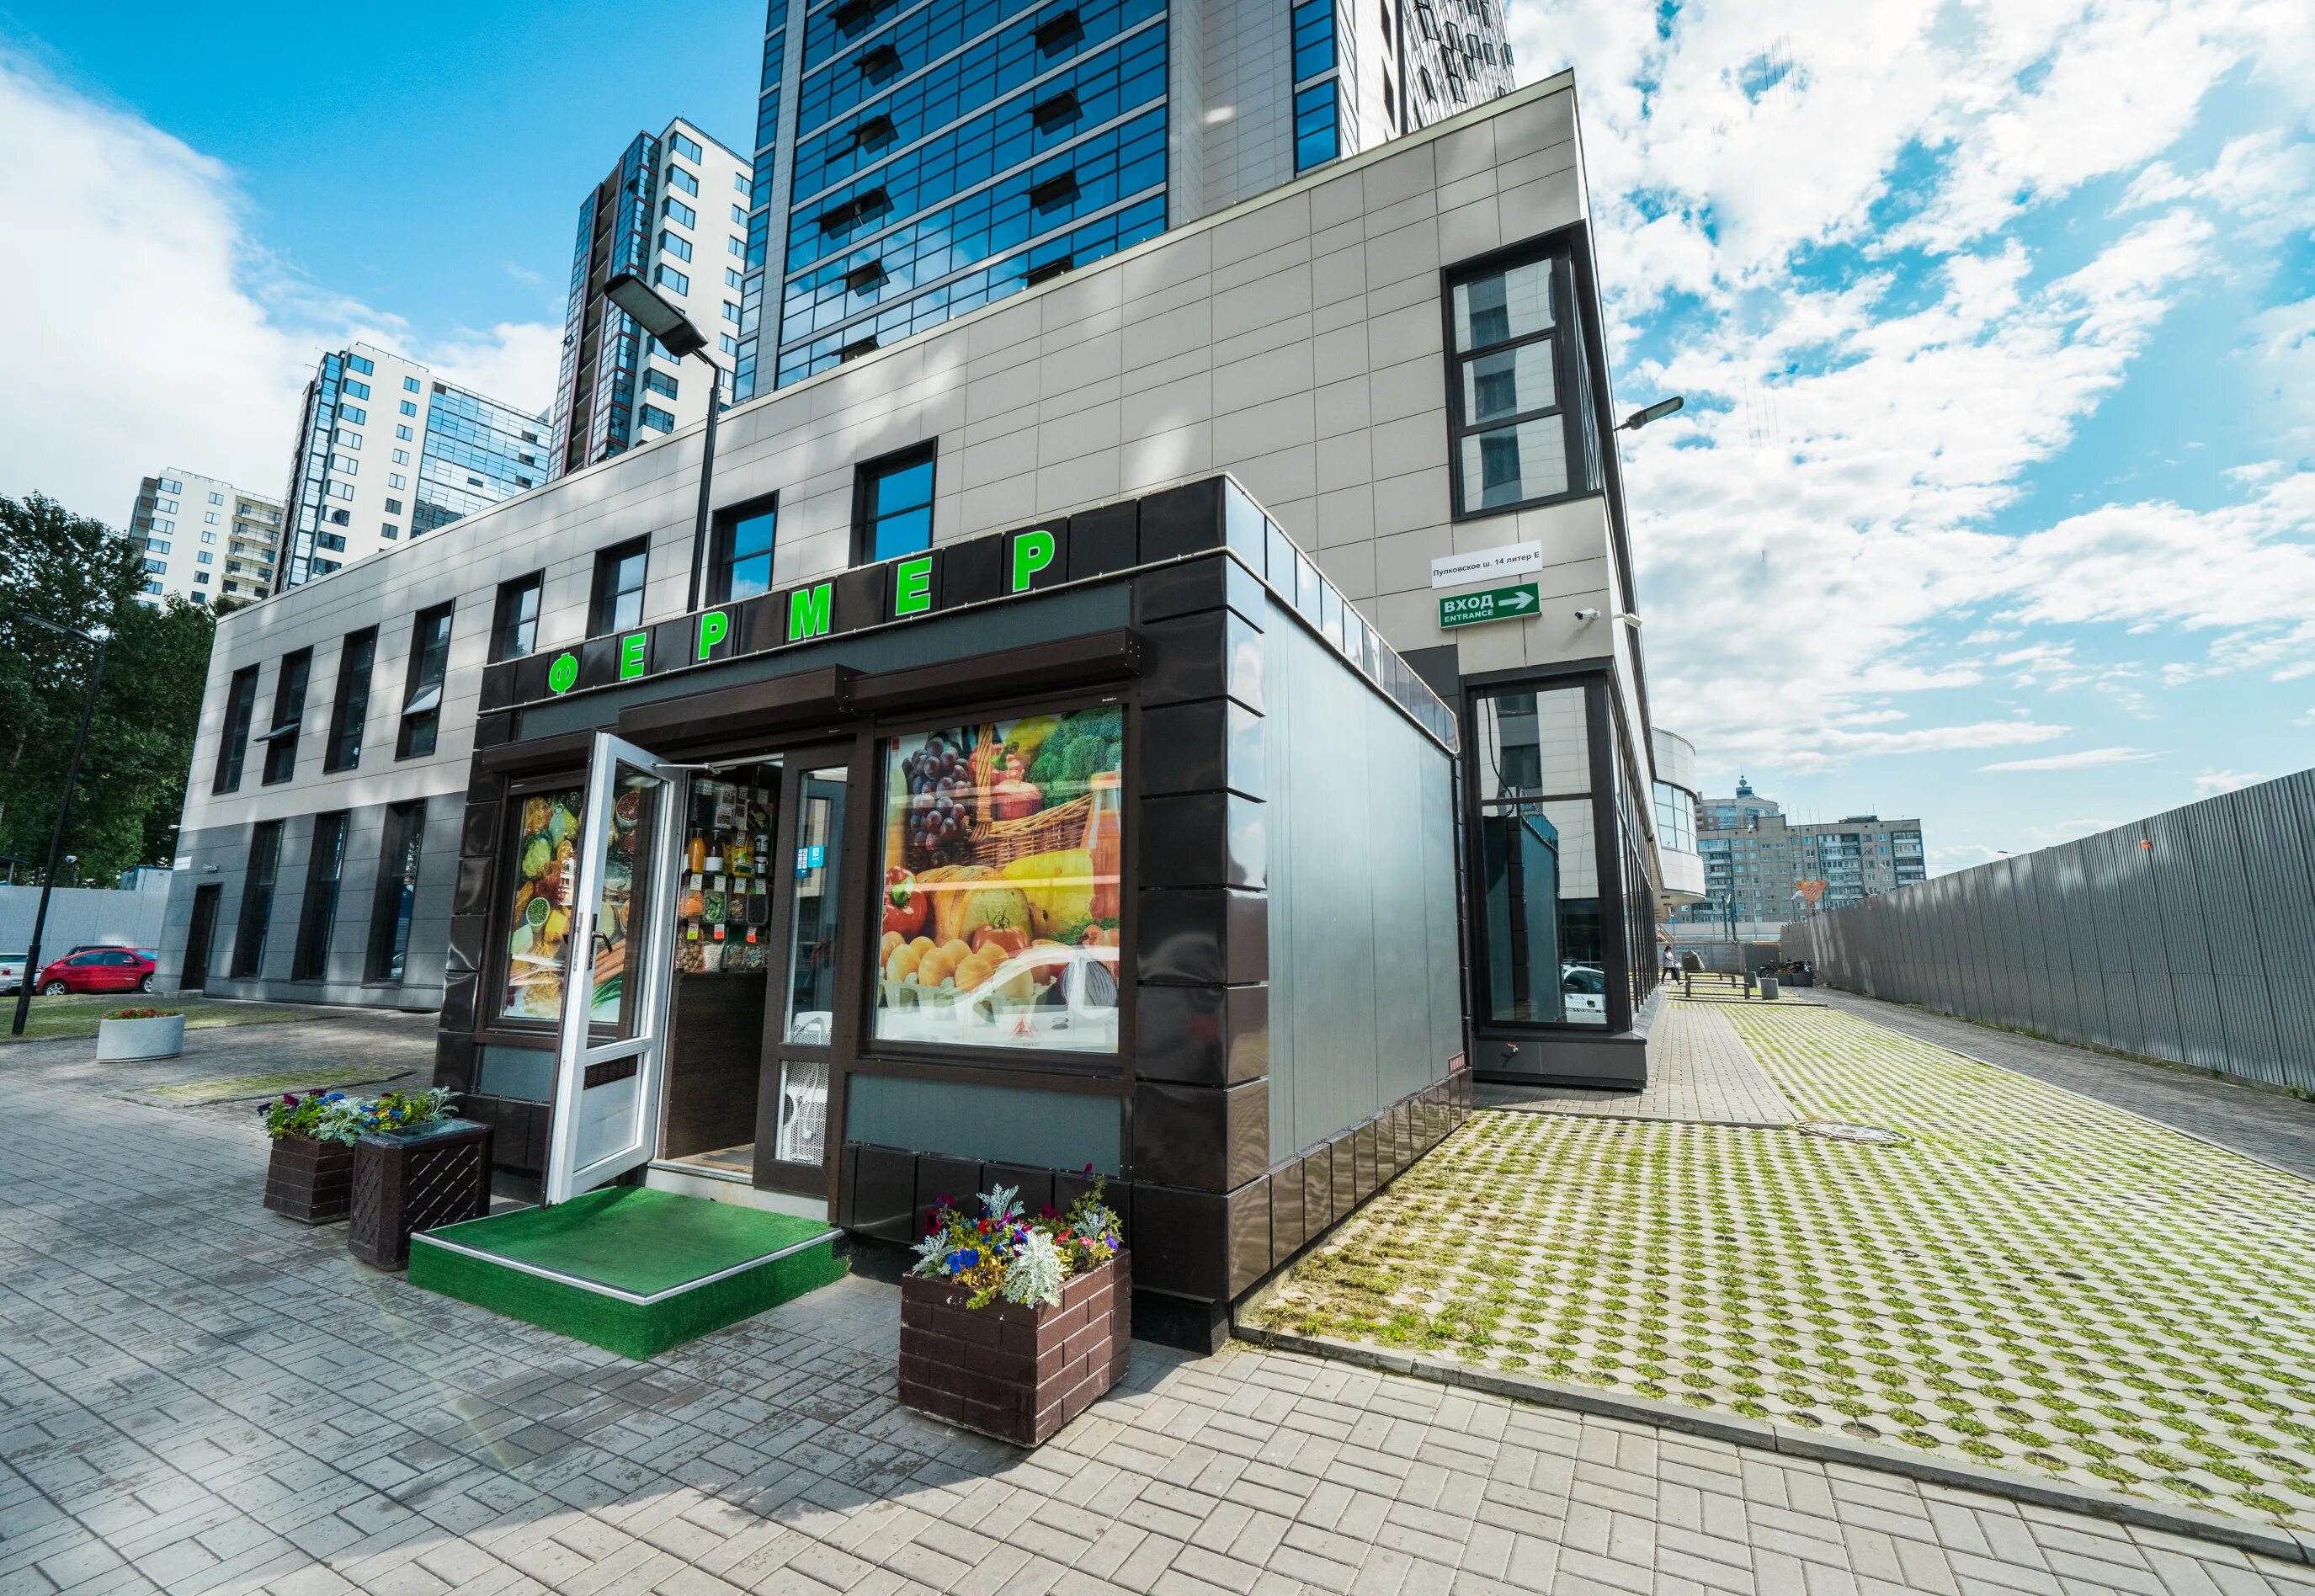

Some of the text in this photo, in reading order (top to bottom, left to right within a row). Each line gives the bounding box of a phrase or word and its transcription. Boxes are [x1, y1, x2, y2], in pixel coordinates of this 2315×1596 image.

[1433, 563, 1481, 577] Пулковское
[1506, 554, 1532, 563] литер
[548, 530, 1056, 695] ФЕРМЕР
[1444, 594, 1494, 613] ВХОД
[1444, 609, 1494, 623] ENTRANCE
